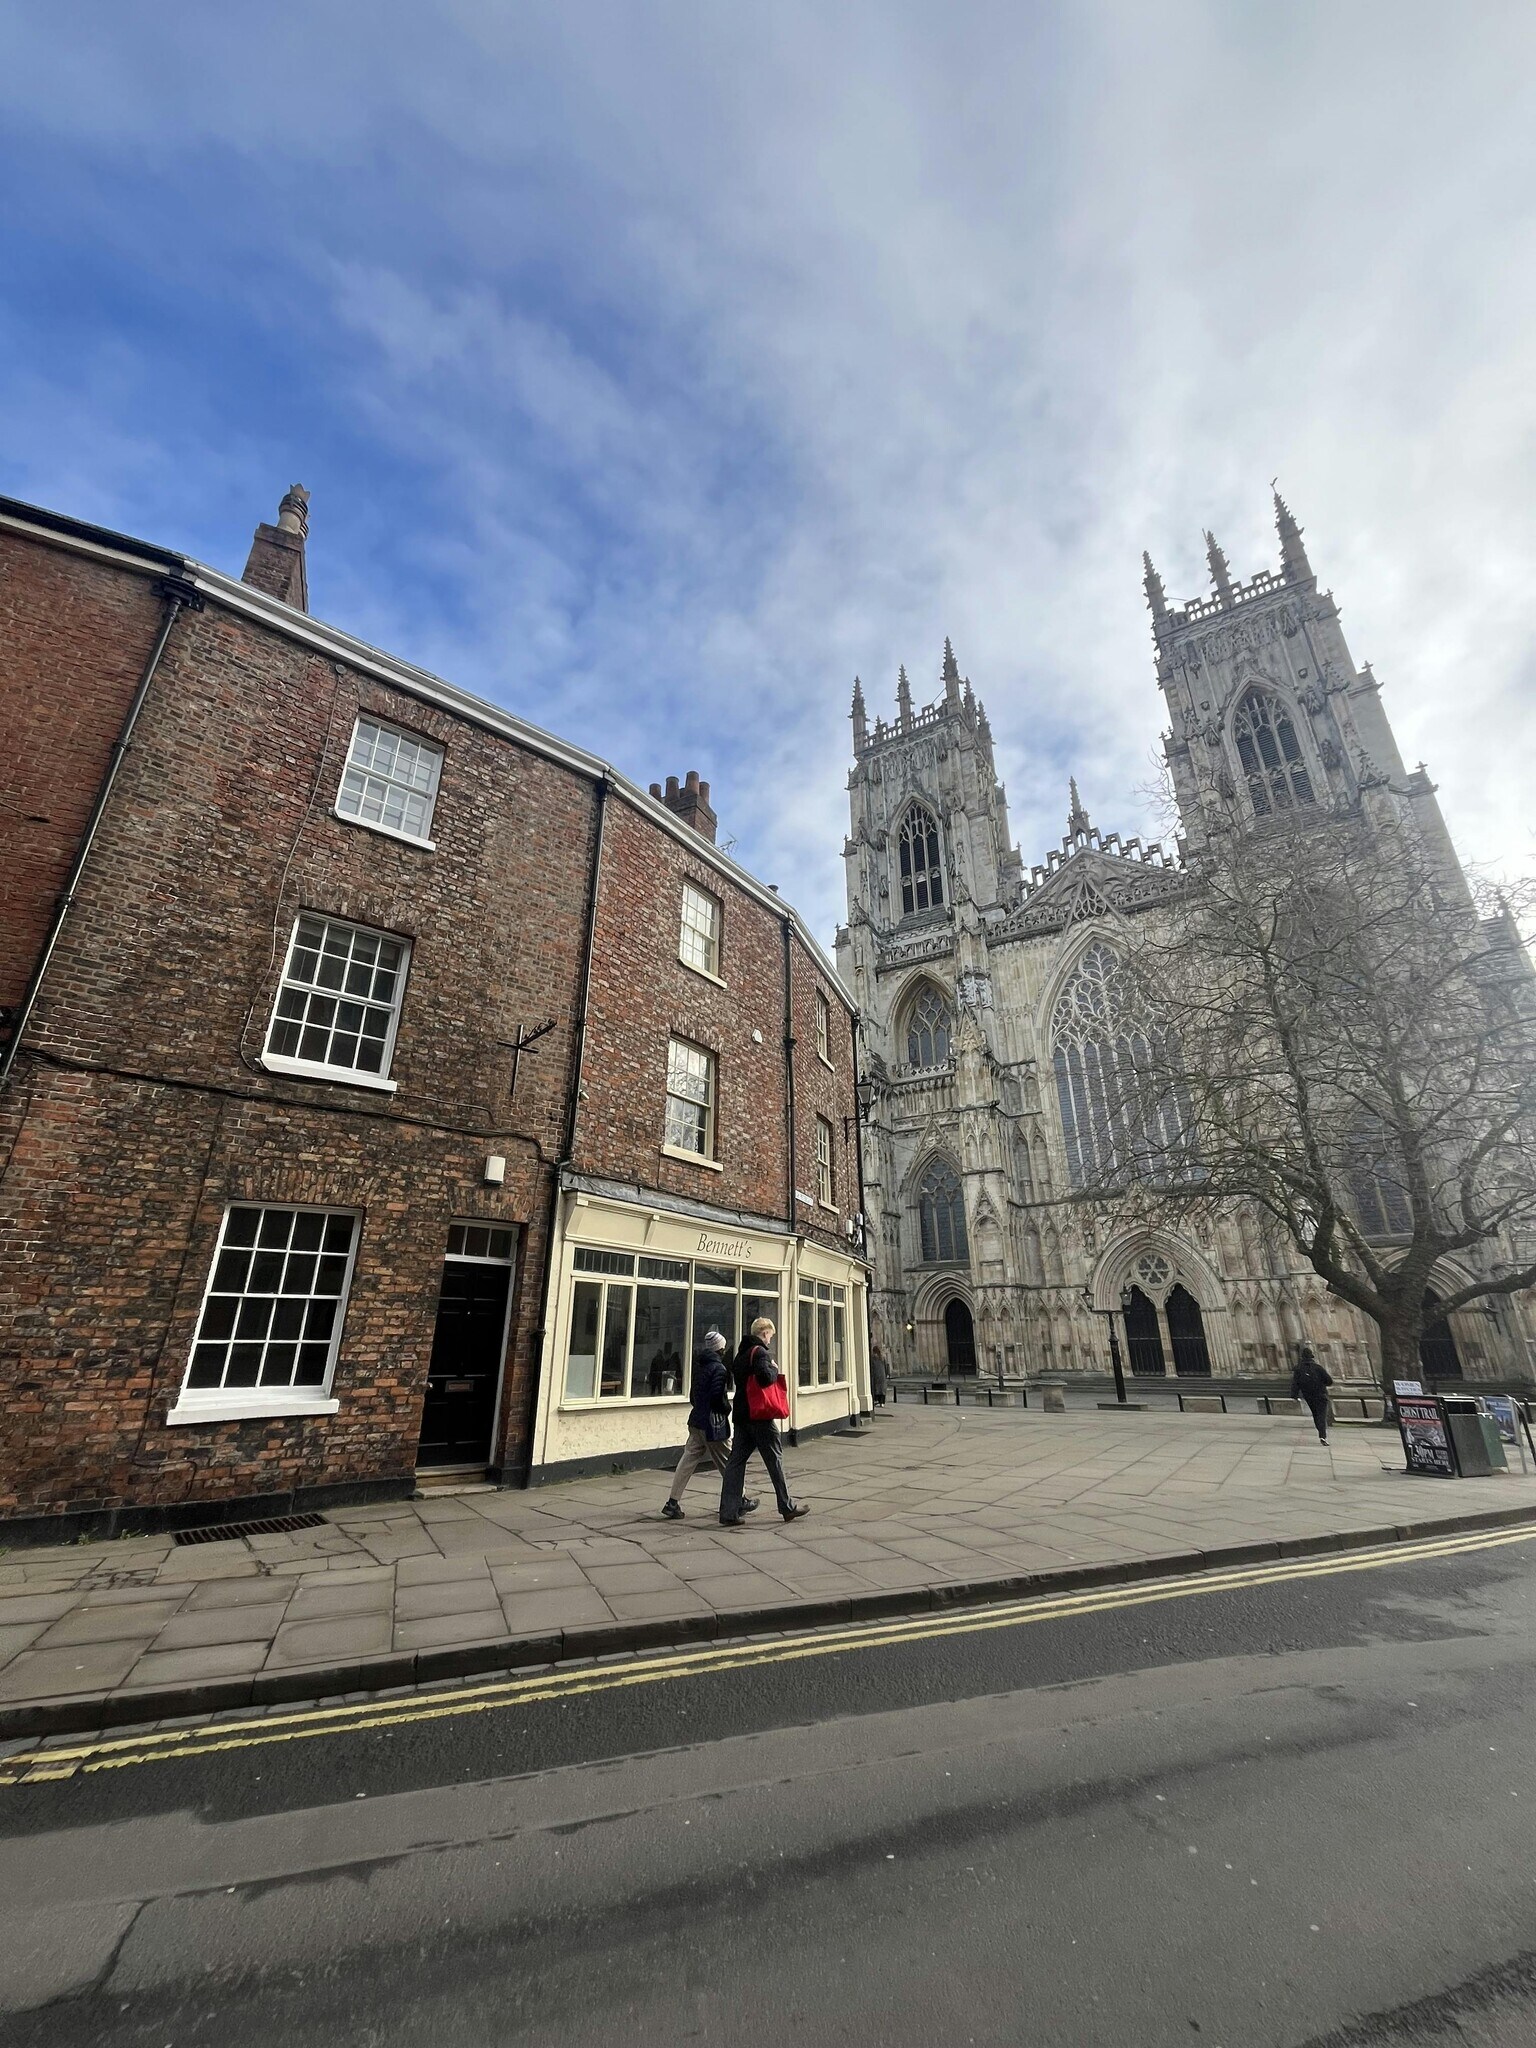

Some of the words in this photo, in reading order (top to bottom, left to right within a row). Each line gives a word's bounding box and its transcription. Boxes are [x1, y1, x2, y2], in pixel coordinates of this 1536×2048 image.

[697, 1233, 752, 1259] Bennett's
[1400, 1406, 1420, 1418] GHOST
[1420, 1407, 1440, 1420] TRAIL
